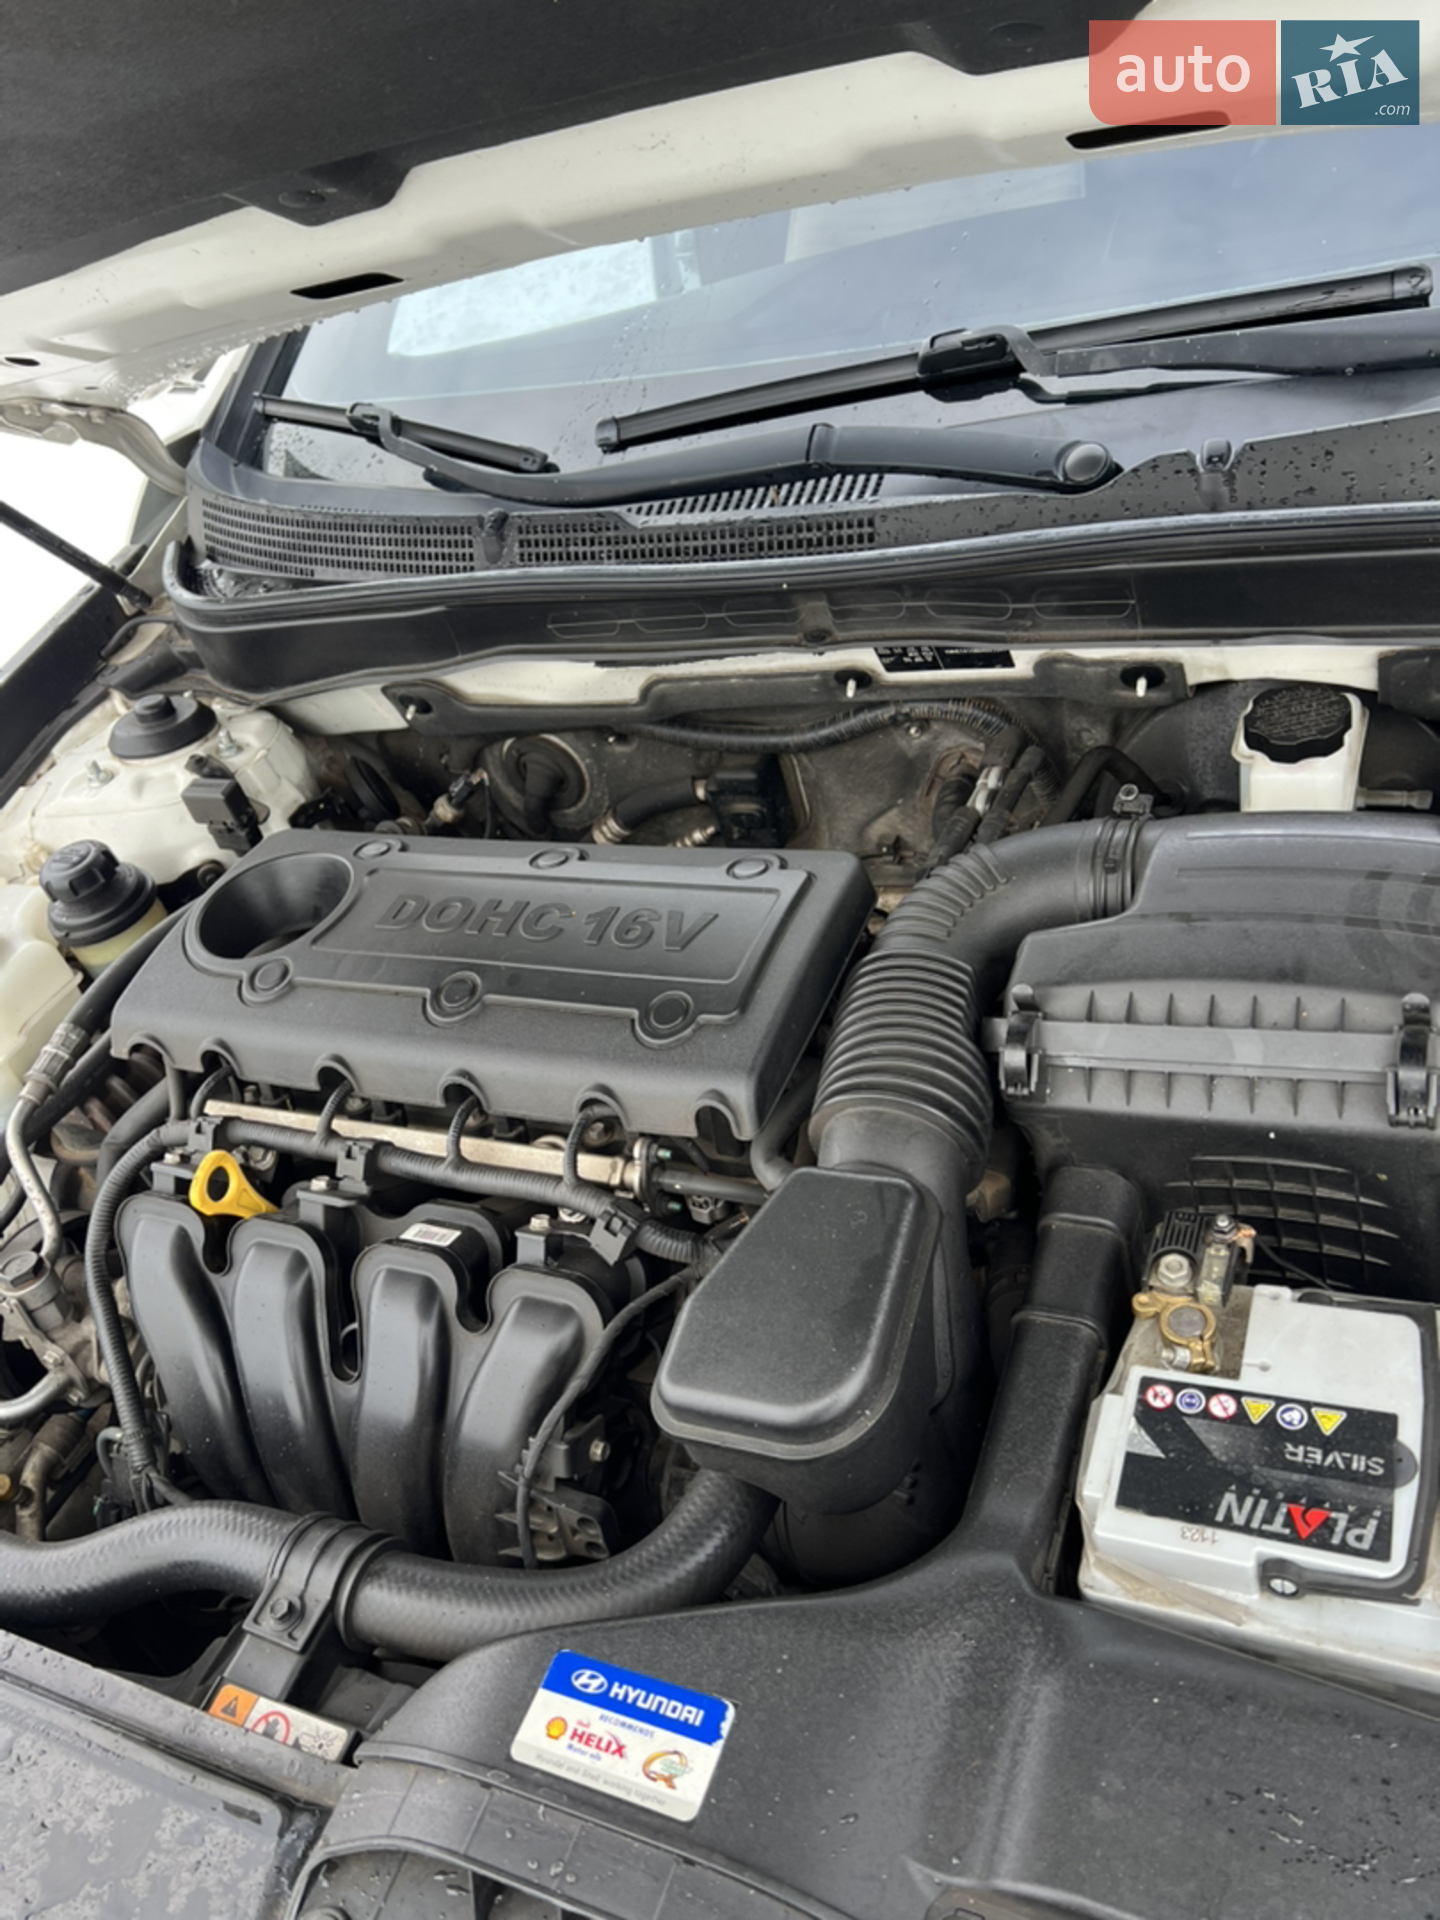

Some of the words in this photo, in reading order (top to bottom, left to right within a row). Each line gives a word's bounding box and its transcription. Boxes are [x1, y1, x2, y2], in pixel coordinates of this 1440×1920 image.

[374, 893, 576, 942] DOHC
[582, 905, 720, 952] 16V
[1284, 1441, 1386, 1477] SILVER
[1180, 1525, 1218, 1545] 1123
[1214, 1490, 1380, 1551] PLATIN
[608, 1681, 706, 1728] HYUNDAI
[569, 1728, 627, 1759] HELIX
[598, 1713, 655, 1739] RECOMMENDS
